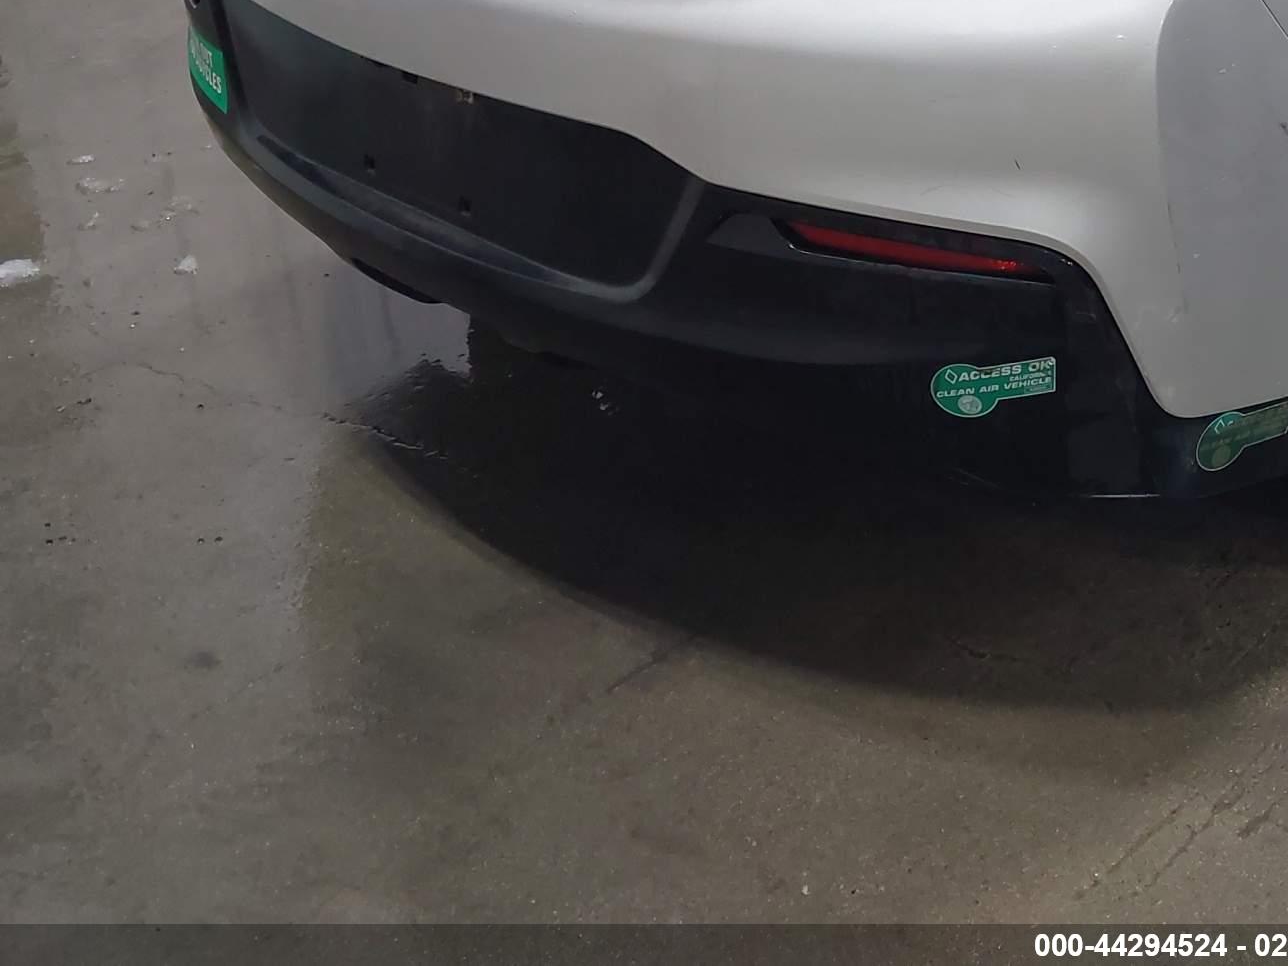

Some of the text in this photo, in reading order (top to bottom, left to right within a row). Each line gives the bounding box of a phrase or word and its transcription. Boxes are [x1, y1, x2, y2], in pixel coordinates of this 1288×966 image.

[958, 359, 1054, 382] ACCESS OK
[1009, 370, 1053, 382] CALIFO
[936, 387, 976, 398] CLEAN
[979, 383, 1000, 394] AIR
[1004, 376, 1053, 390] VEHICLE
